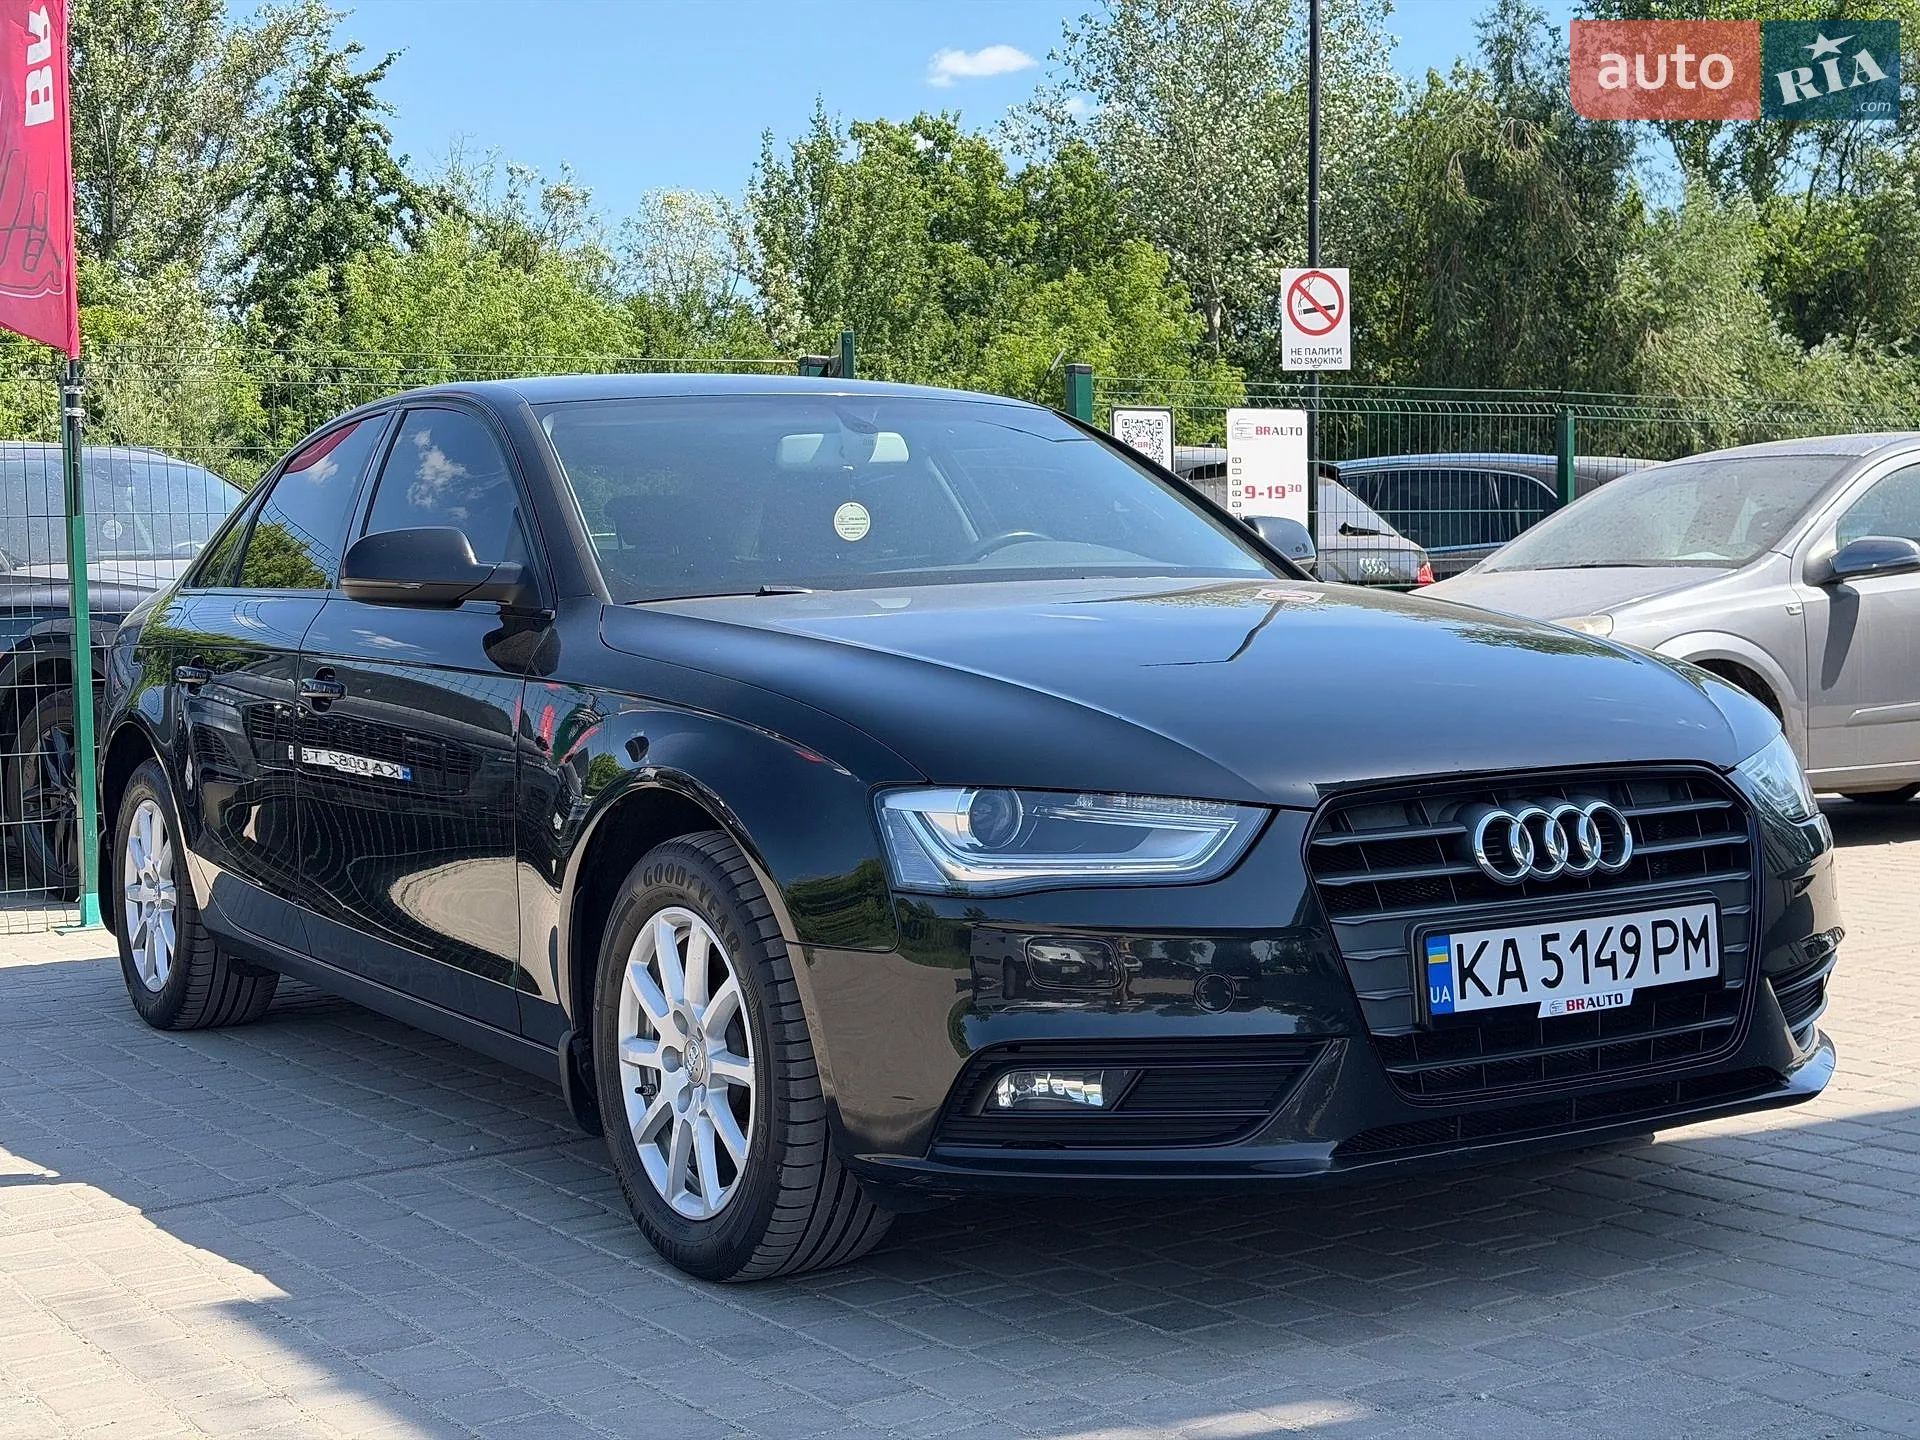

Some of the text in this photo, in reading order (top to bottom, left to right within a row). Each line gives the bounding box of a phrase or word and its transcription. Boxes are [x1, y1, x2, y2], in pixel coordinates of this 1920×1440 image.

[1290, 347, 1343, 356] НЕ ПАЛИТИ
[1290, 357, 1343, 365] NO SMOKING
[1255, 426, 1303, 437] BRAUTO
[1456, 914, 1711, 1000] KA 5149 PM
[1430, 990, 1451, 1004] UA
[1566, 993, 1624, 1012] BRAUTO
